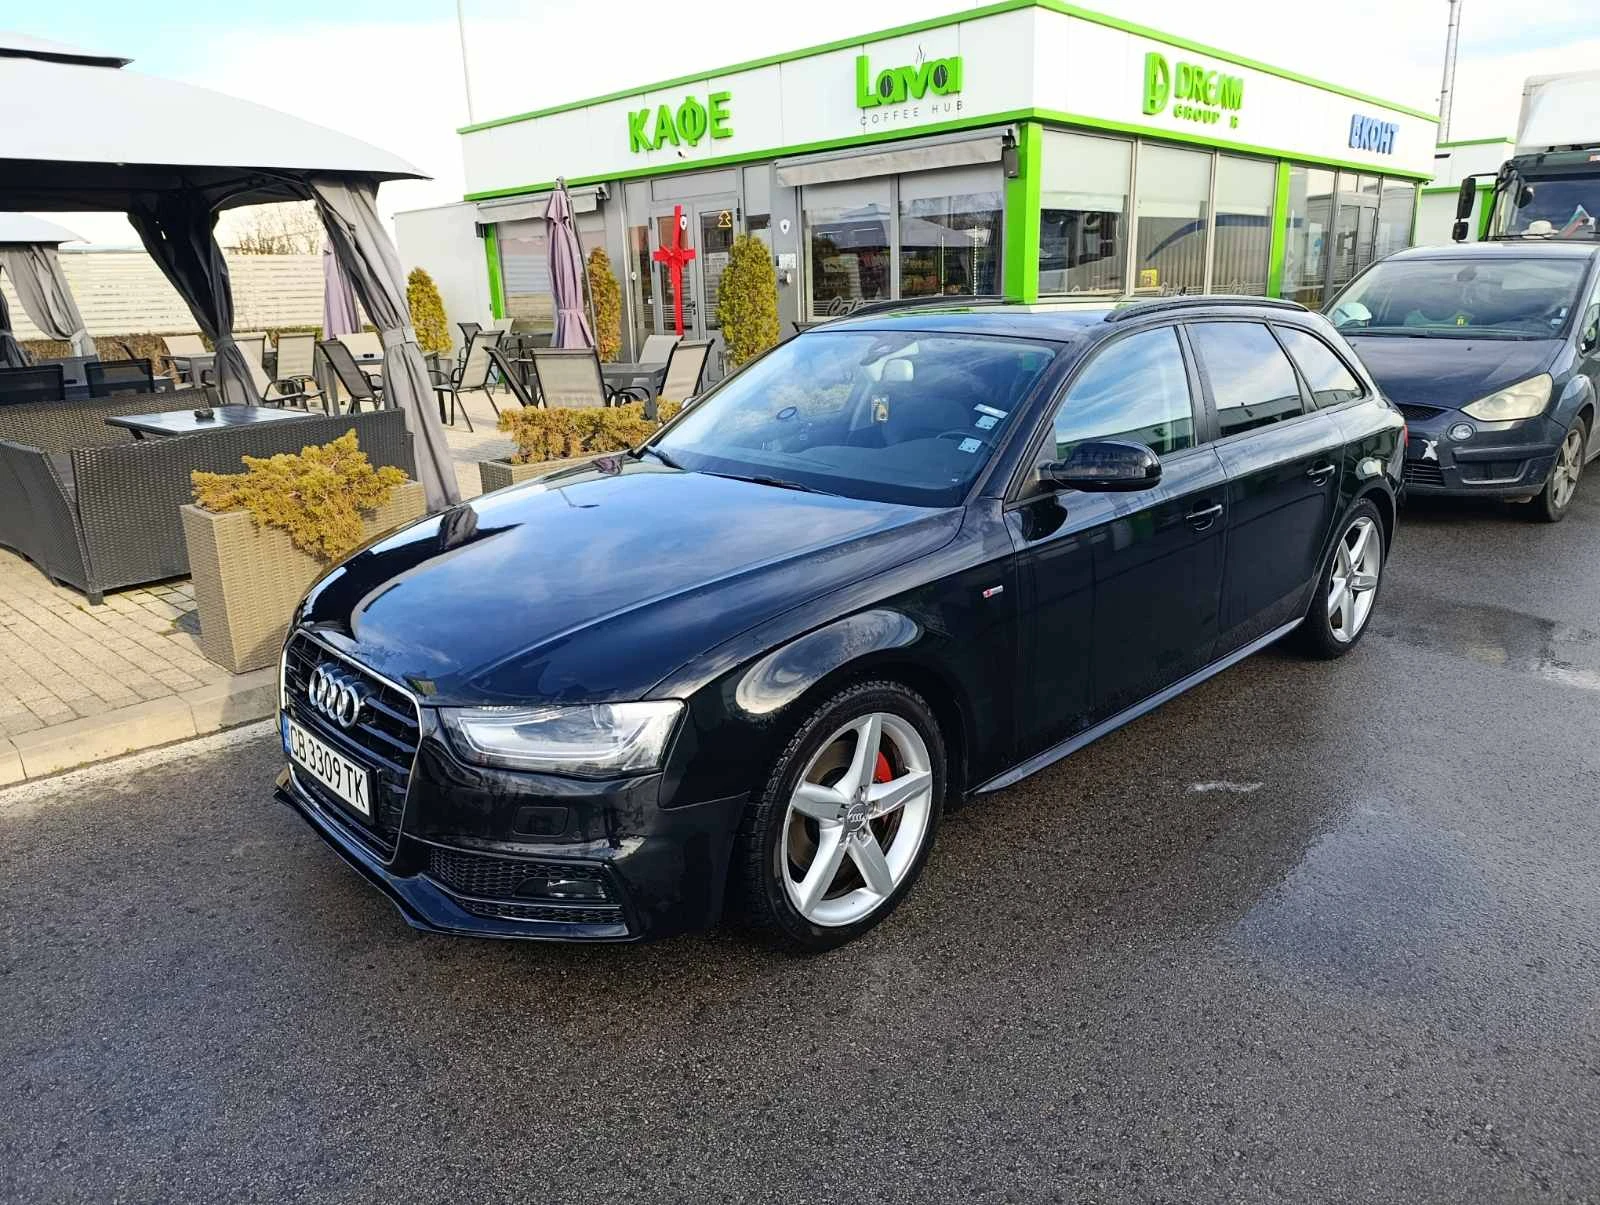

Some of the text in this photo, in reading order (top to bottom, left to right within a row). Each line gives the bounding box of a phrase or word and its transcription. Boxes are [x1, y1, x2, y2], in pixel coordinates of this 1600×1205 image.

[856, 56, 962, 108] Lava
[1174, 62, 1243, 111] DREAM
[628, 91, 734, 153] КАФЕ
[860, 100, 963, 126] COFFEE HUB
[1173, 104, 1220, 124] GROUP
[290, 725, 366, 809] CB 3309 TK
